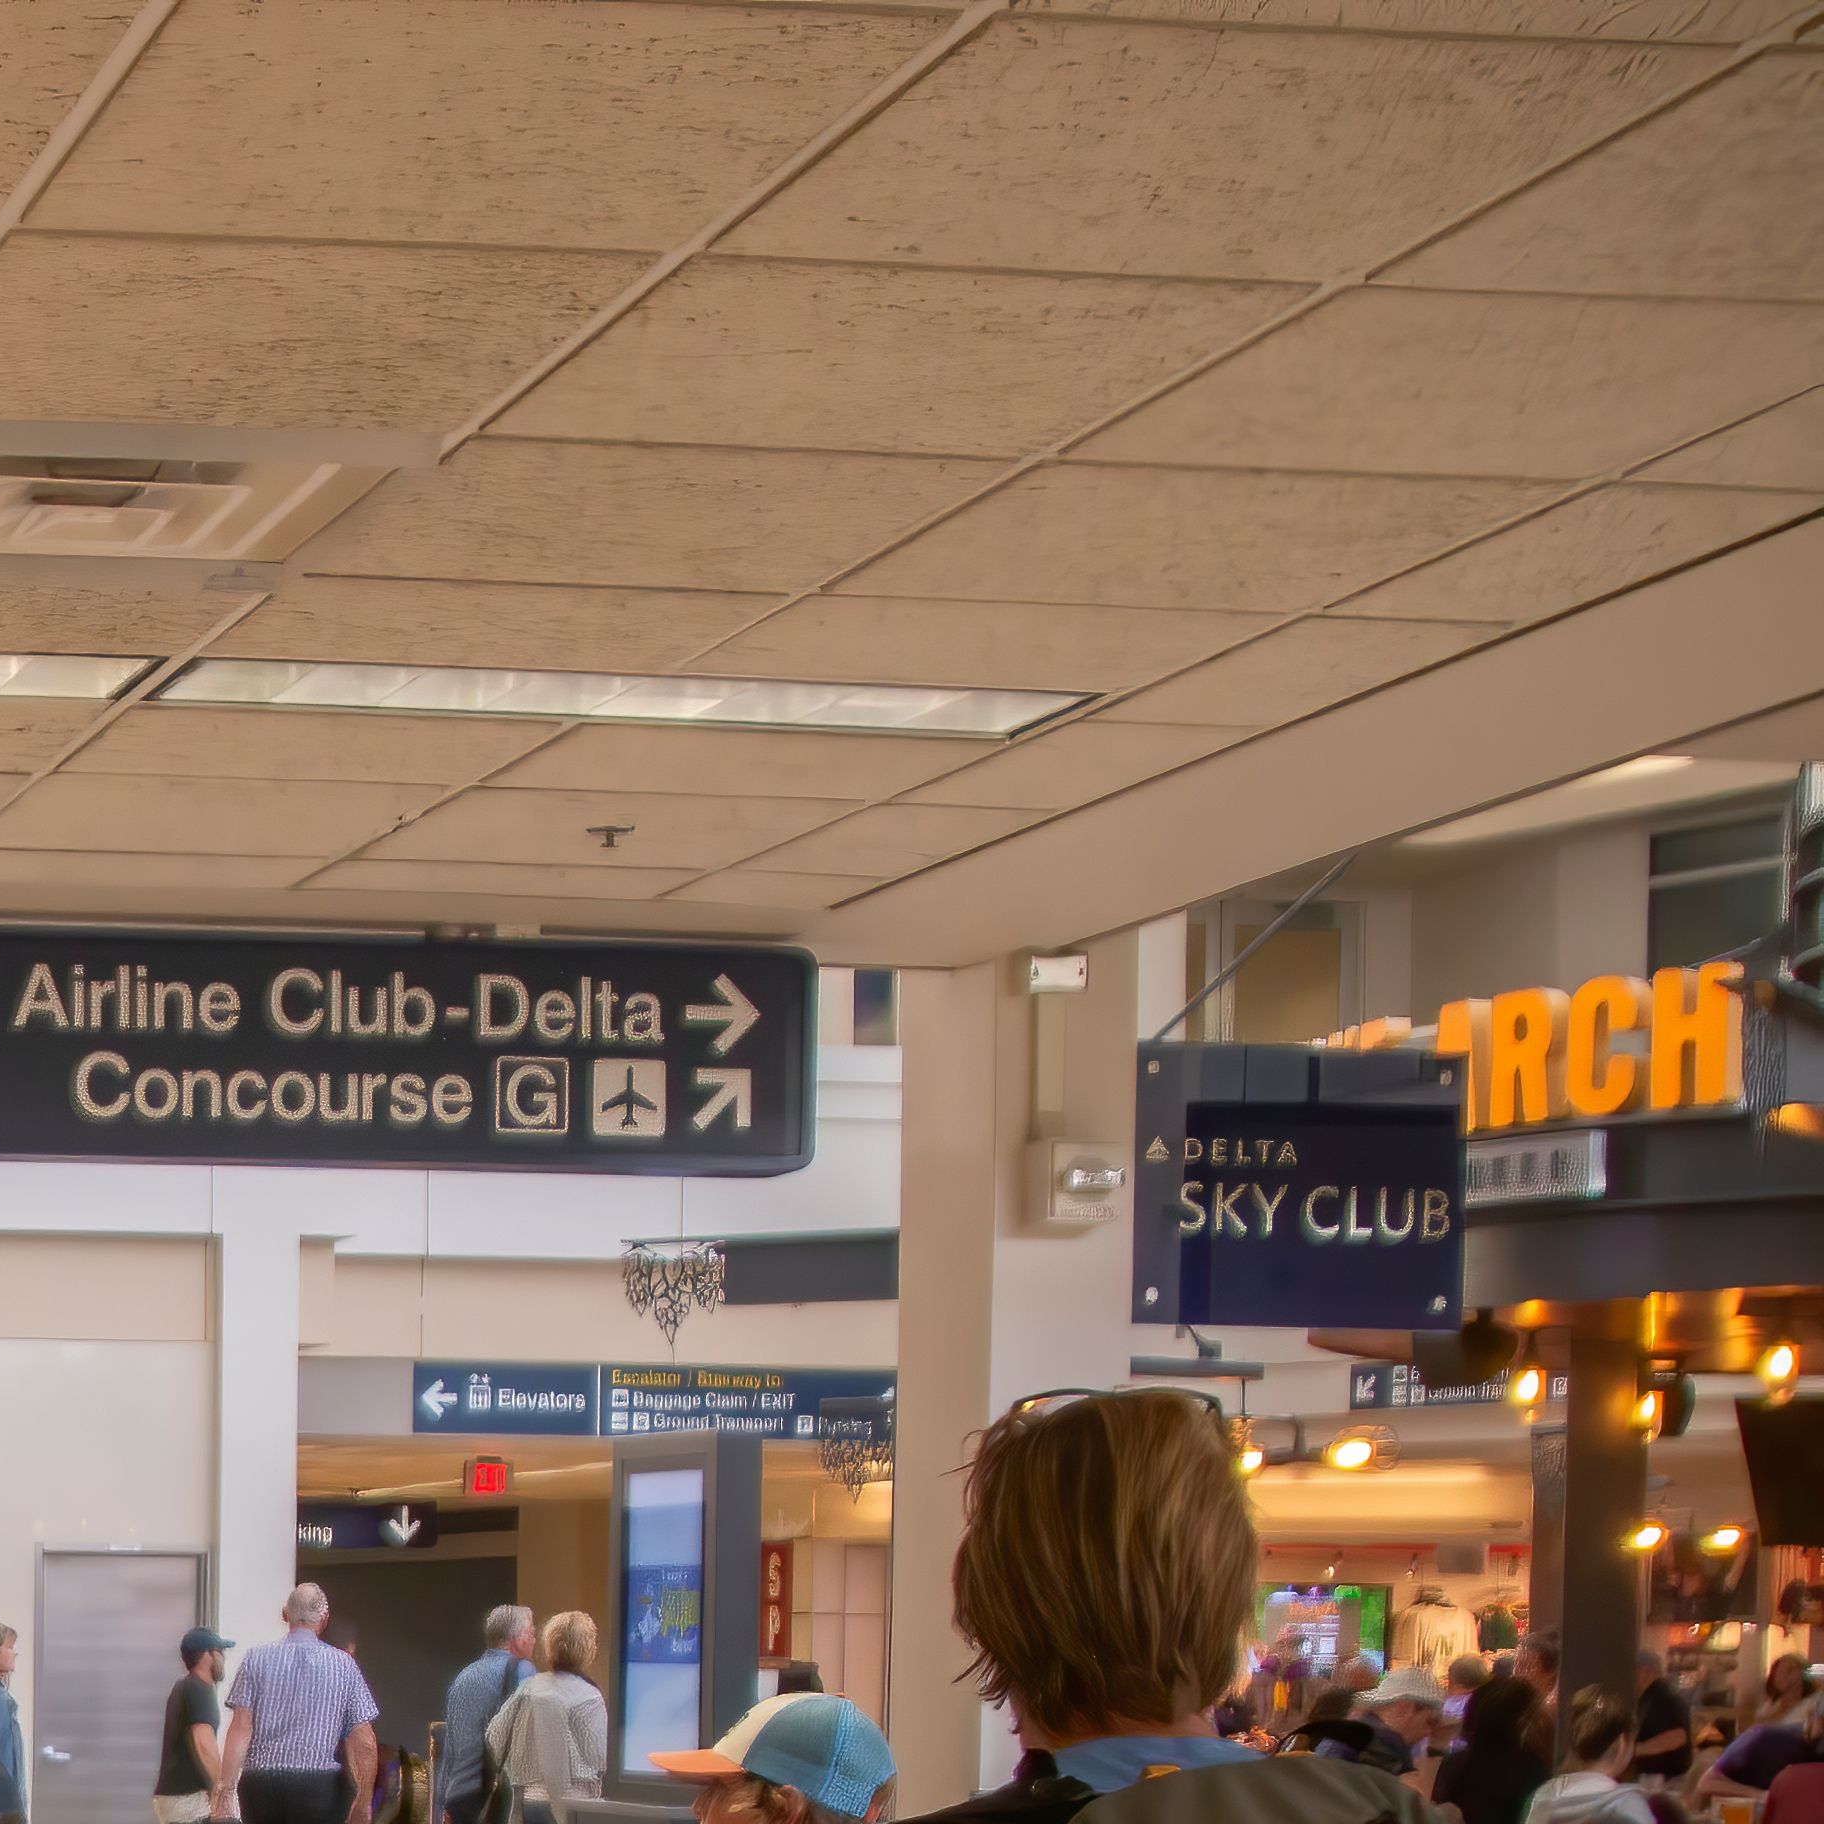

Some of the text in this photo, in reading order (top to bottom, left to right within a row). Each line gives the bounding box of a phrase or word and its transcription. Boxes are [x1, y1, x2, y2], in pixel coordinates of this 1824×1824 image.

[12, 963, 665, 1044] Airline Club-Delta
[73, 1050, 474, 1127] Concourse
[1183, 1138, 1298, 1167] DELTA
[1179, 1180, 1452, 1243] SKY CLUB
[497, 1387, 587, 1412] Elevators
[632, 1391, 702, 1411] Baggage
[705, 1392, 748, 1409] Claim
[761, 1392, 797, 1411] EXIT
[653, 1412, 710, 1430] Ground
[297, 1523, 333, 1548] king
